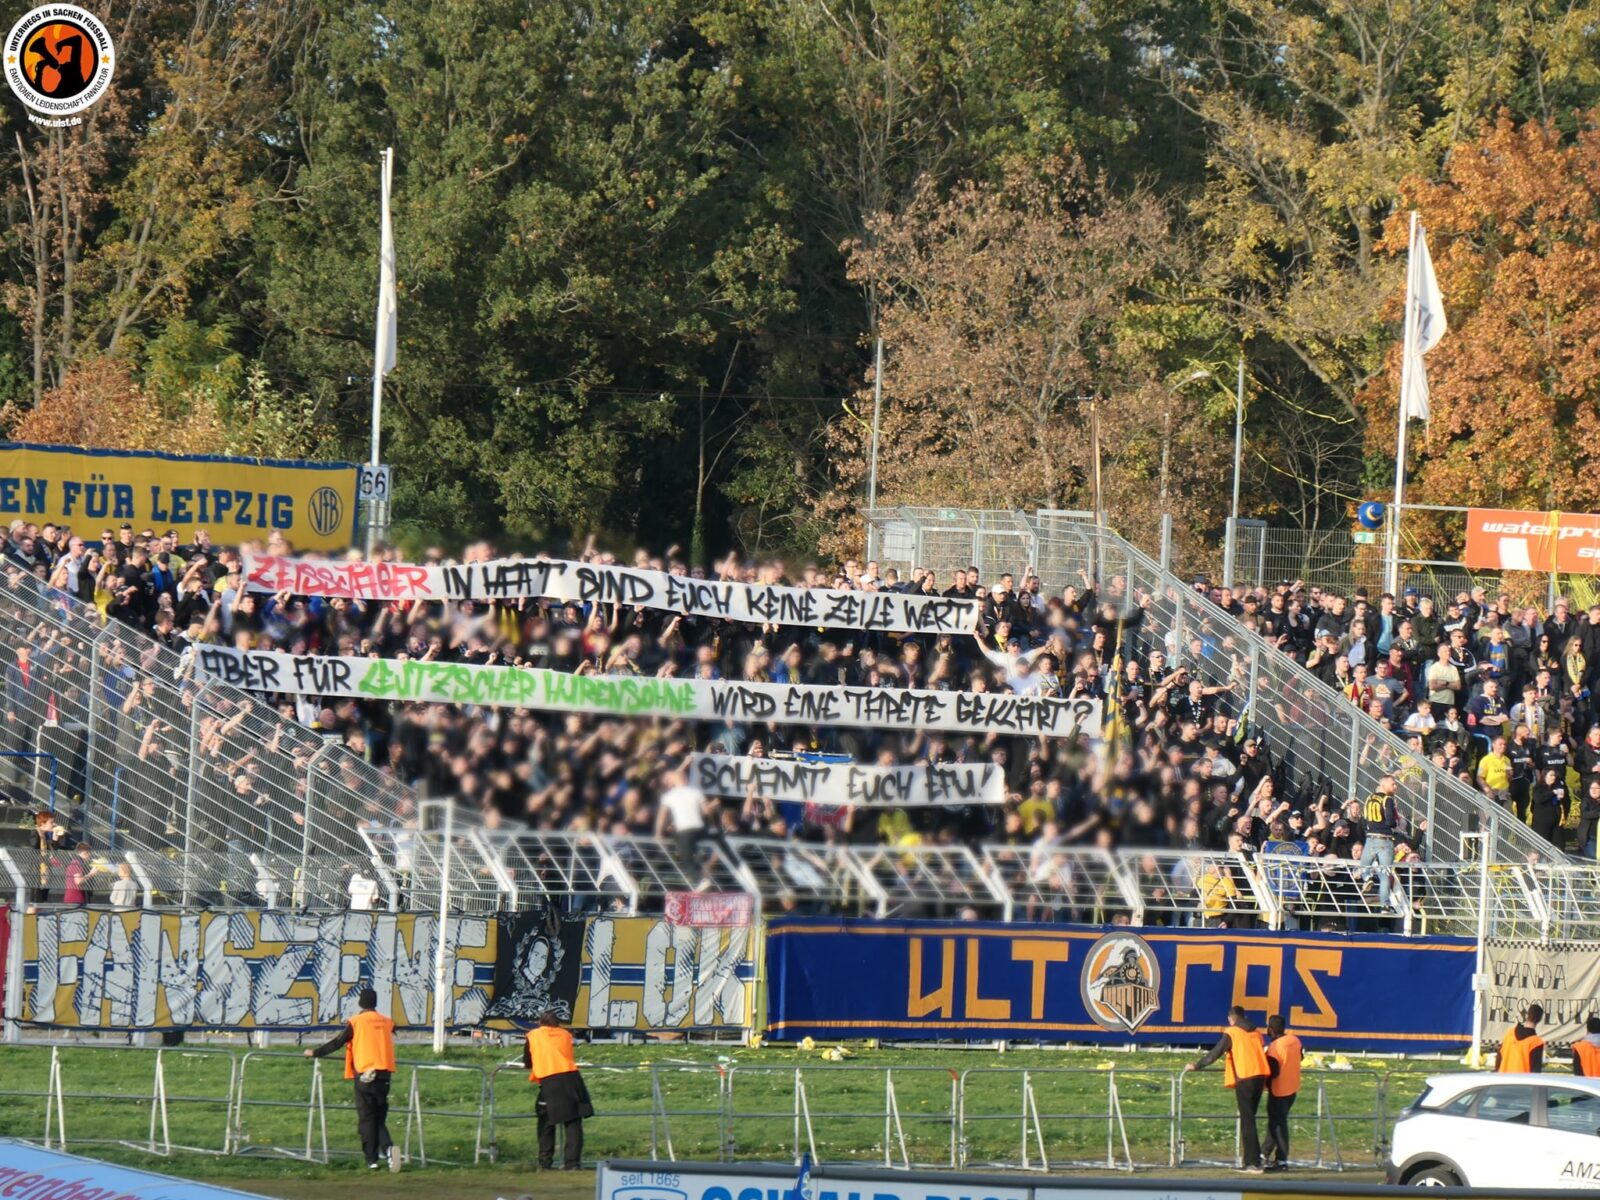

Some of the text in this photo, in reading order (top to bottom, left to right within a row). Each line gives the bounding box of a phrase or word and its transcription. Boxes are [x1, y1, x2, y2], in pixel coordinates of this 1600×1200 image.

[62, 474, 134, 518] FÜR
[151, 486, 293, 529] LEIPZIG
[362, 470, 386, 497] 66
[442, 566, 473, 599] IN
[482, 561, 568, 595] HAFT
[576, 567, 655, 601] SIND
[665, 575, 733, 614] EUCH
[747, 587, 818, 622] KEINE
[823, 593, 894, 628] ZEILE
[200, 650, 280, 690] ABER
[293, 656, 352, 693] FÜR
[711, 685, 776, 718] WIRD
[785, 686, 841, 721] EINE
[699, 756, 831, 798] SCHÄMT
[846, 766, 914, 801] EUCH
[1368, 801, 1382, 822] 10
[586, 917, 753, 1030] LOK
[1494, 960, 1568, 990] BANDA
[1489, 995, 1600, 1026] RESLUTA
[621, 1172, 680, 1188] seit 1865
